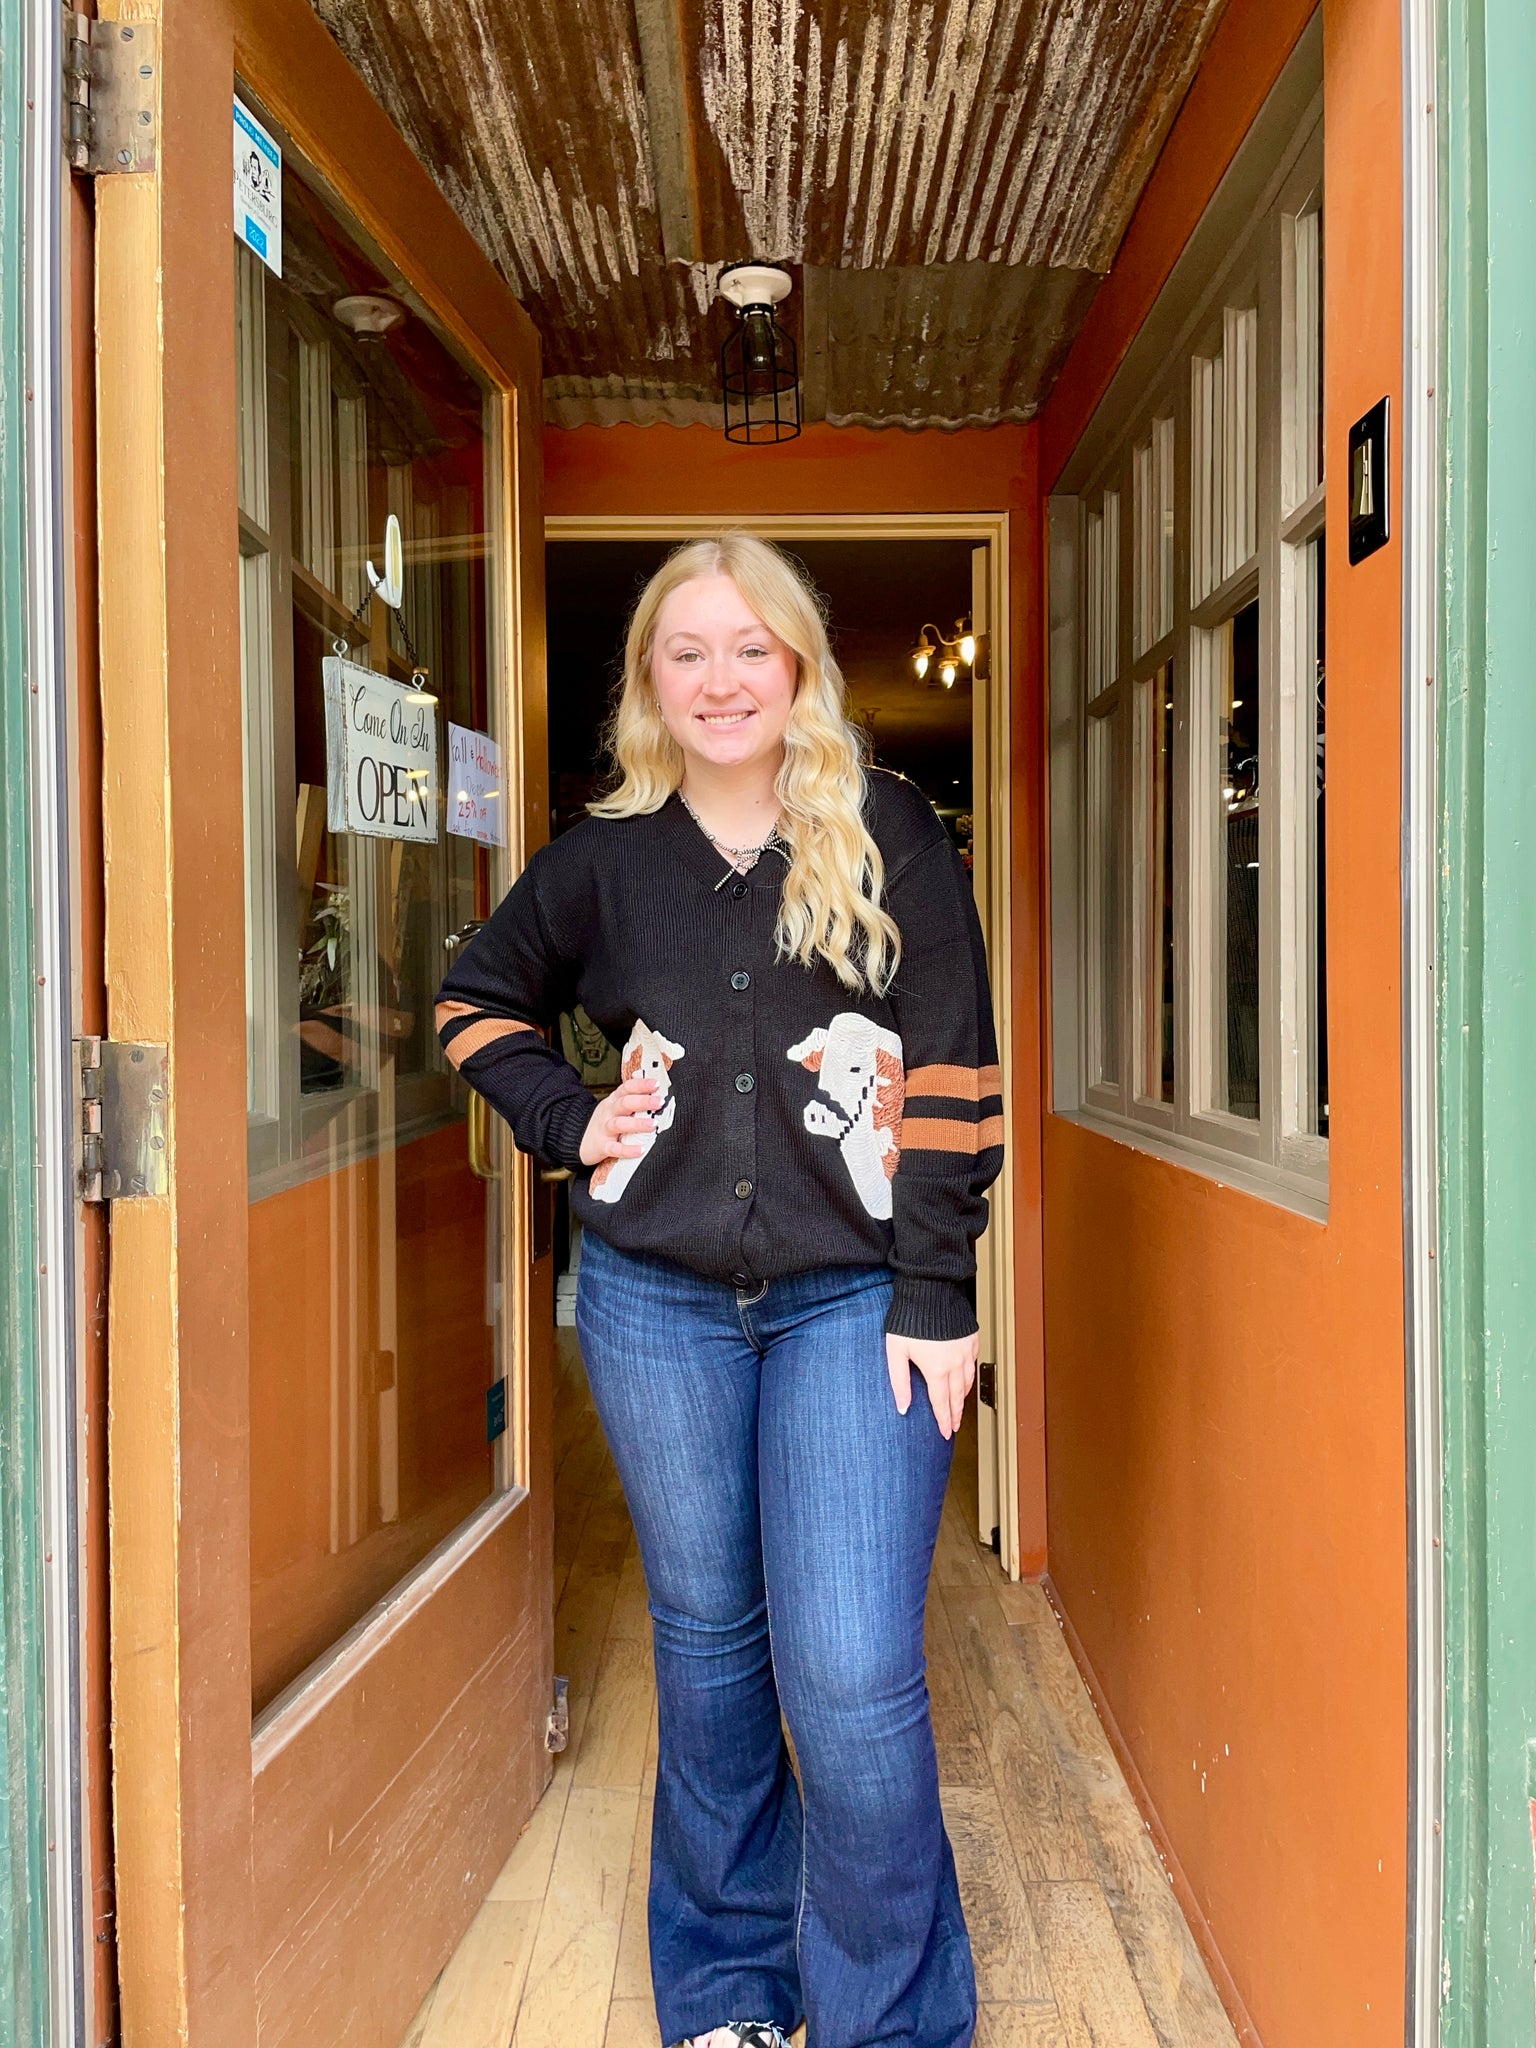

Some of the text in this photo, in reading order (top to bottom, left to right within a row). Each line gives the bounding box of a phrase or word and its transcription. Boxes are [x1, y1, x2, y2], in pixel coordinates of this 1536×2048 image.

[235, 109, 279, 162] PROUD MEMBER
[232, 168, 278, 229] PETERSBURG
[248, 226, 265, 250] 2022
[349, 683, 431, 752] Come On In
[450, 726, 467, 764] Fall
[357, 756, 429, 829] OPEN
[458, 799, 477, 819] 25%
